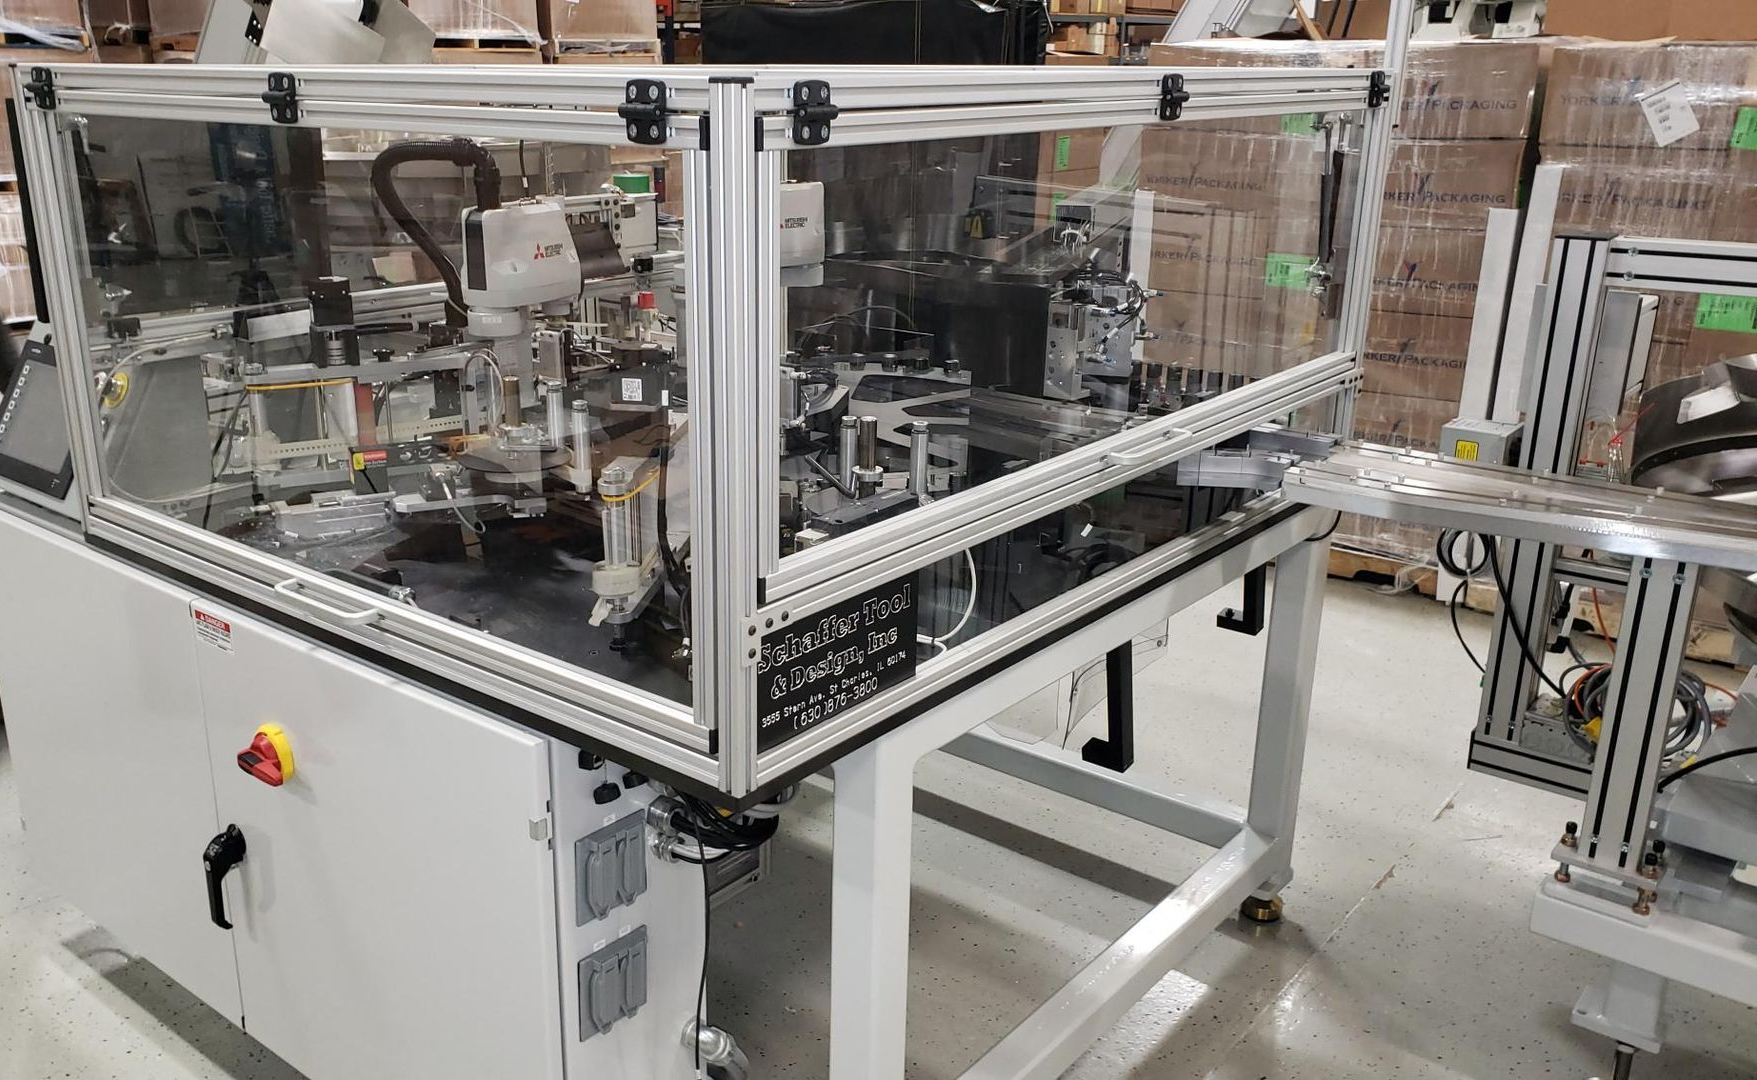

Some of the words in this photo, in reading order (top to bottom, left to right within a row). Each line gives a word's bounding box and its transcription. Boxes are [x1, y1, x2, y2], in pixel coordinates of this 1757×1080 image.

[1423, 191, 1506, 204] PACKAGING
[758, 612, 860, 675] Schaffer
[863, 584, 911, 626] Tool
[771, 674, 787, 699] &
[790, 645, 865, 692] Design,
[867, 627, 898, 655] Inc
[762, 710, 781, 728] 3555
[784, 700, 806, 717] Stern
[809, 692, 826, 704] Ave.
[829, 684, 839, 695] St
[877, 661, 885, 672] IL
[887, 650, 907, 666] 60174
